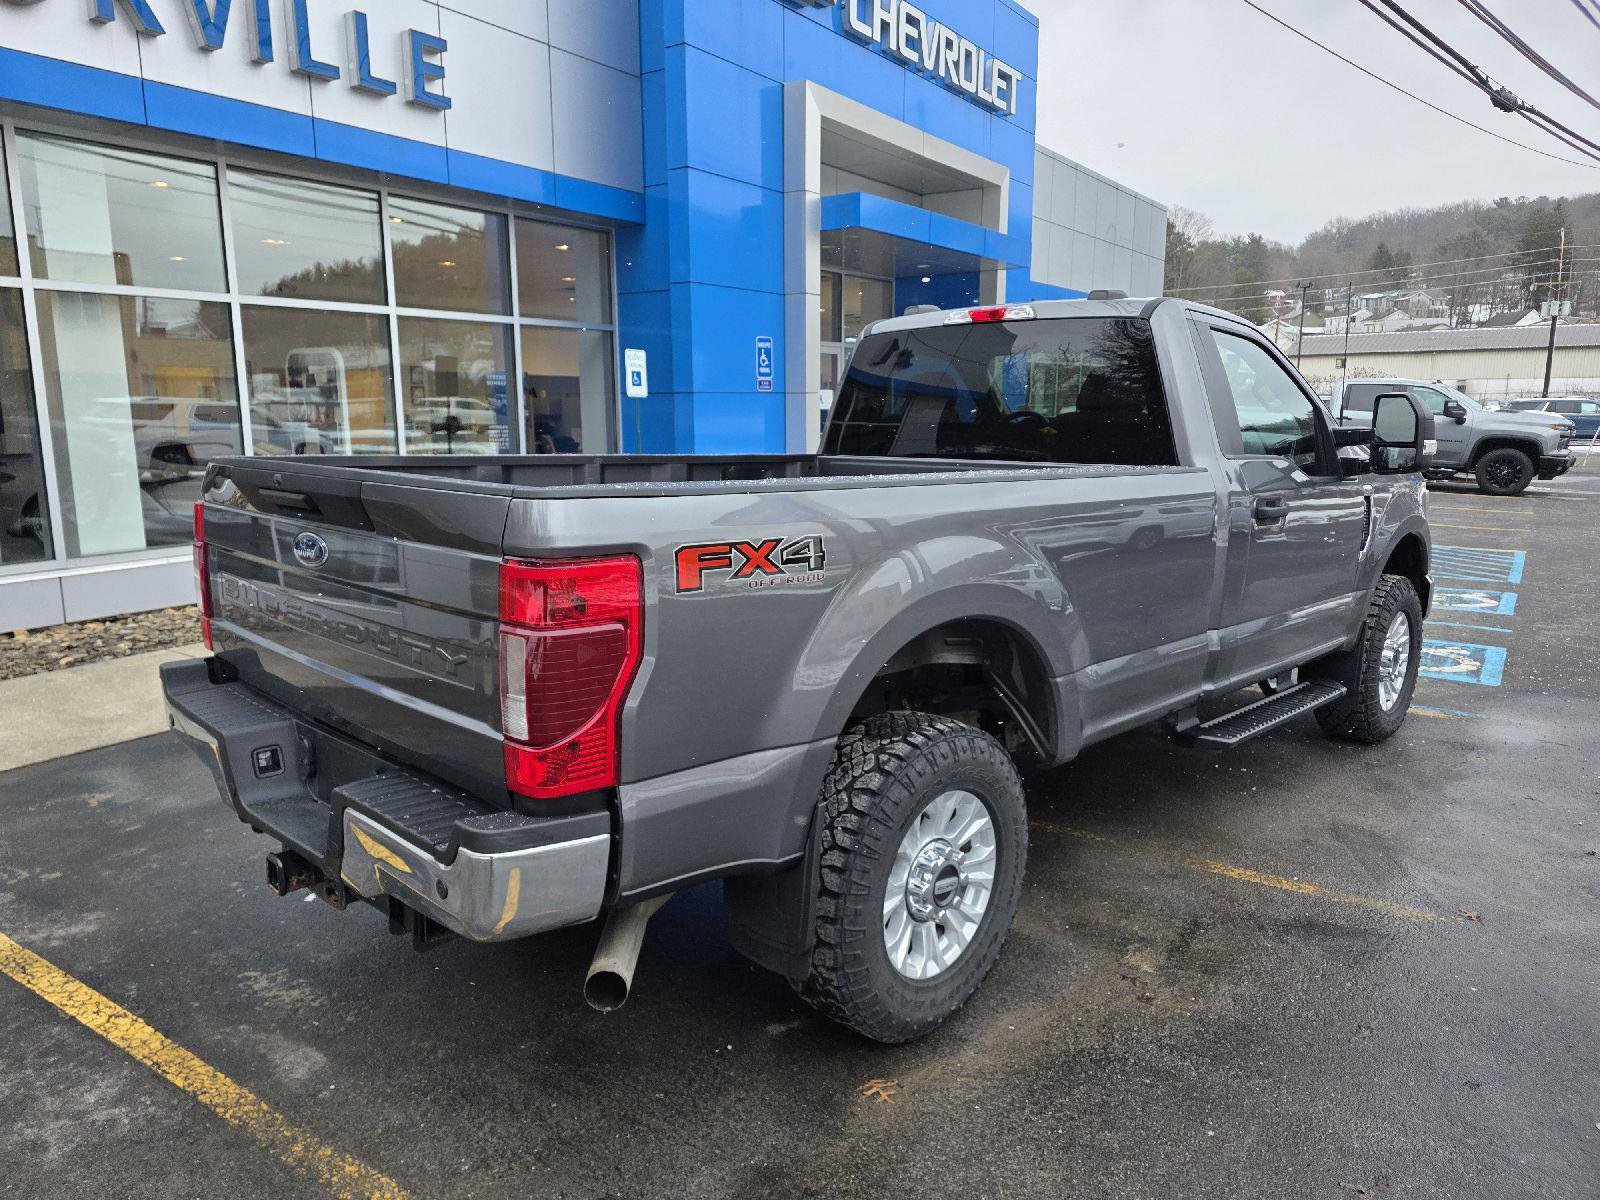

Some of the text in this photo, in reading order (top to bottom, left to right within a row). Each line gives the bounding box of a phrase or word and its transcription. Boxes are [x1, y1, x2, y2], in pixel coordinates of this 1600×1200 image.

[843, 0, 1022, 116] CHEVROLET
[674, 533, 827, 595] FX4
[747, 572, 826, 589] OFF ROAD
